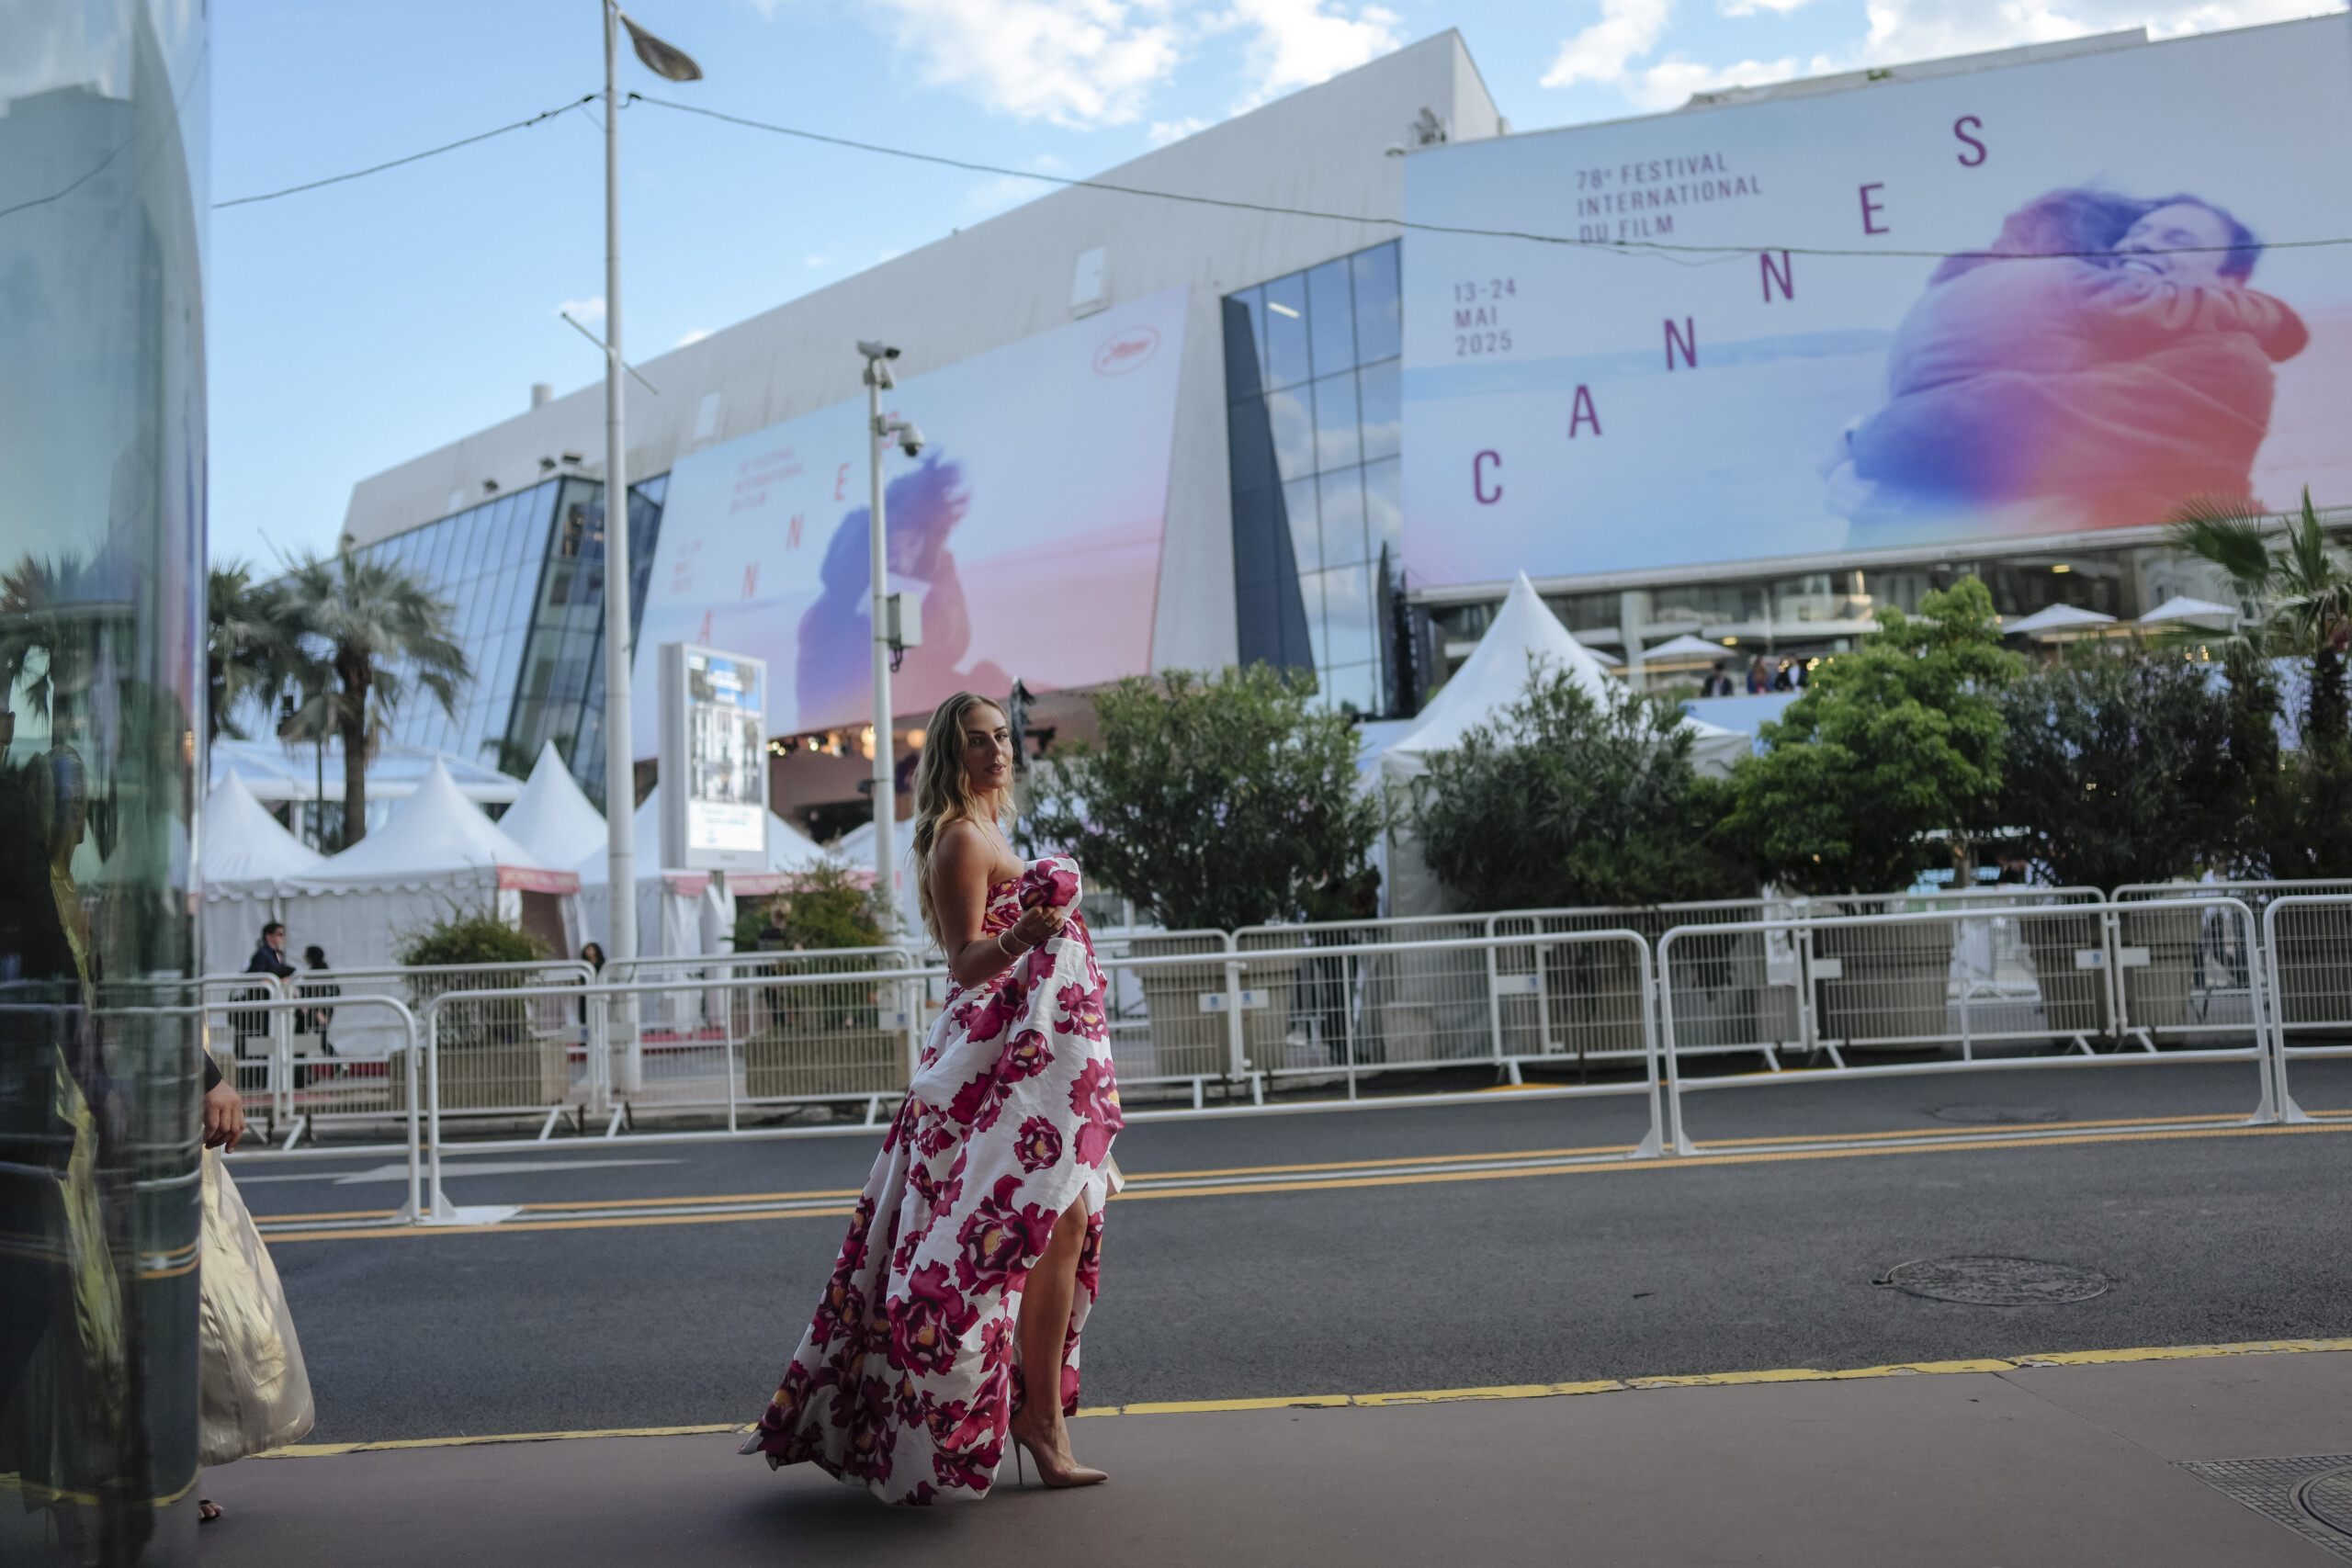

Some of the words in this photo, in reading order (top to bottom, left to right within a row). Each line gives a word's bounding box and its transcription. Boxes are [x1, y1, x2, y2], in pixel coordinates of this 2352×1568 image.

[1620, 152, 1728, 185] FESTIVAL
[1577, 175, 1763, 218] INTERNATIONAL
[1578, 221, 1610, 243] DU
[1618, 212, 1674, 240] FILM
[1453, 277, 1516, 303] 13-24
[1453, 306, 1498, 328] MAI
[1453, 330, 1513, 355] 2025
